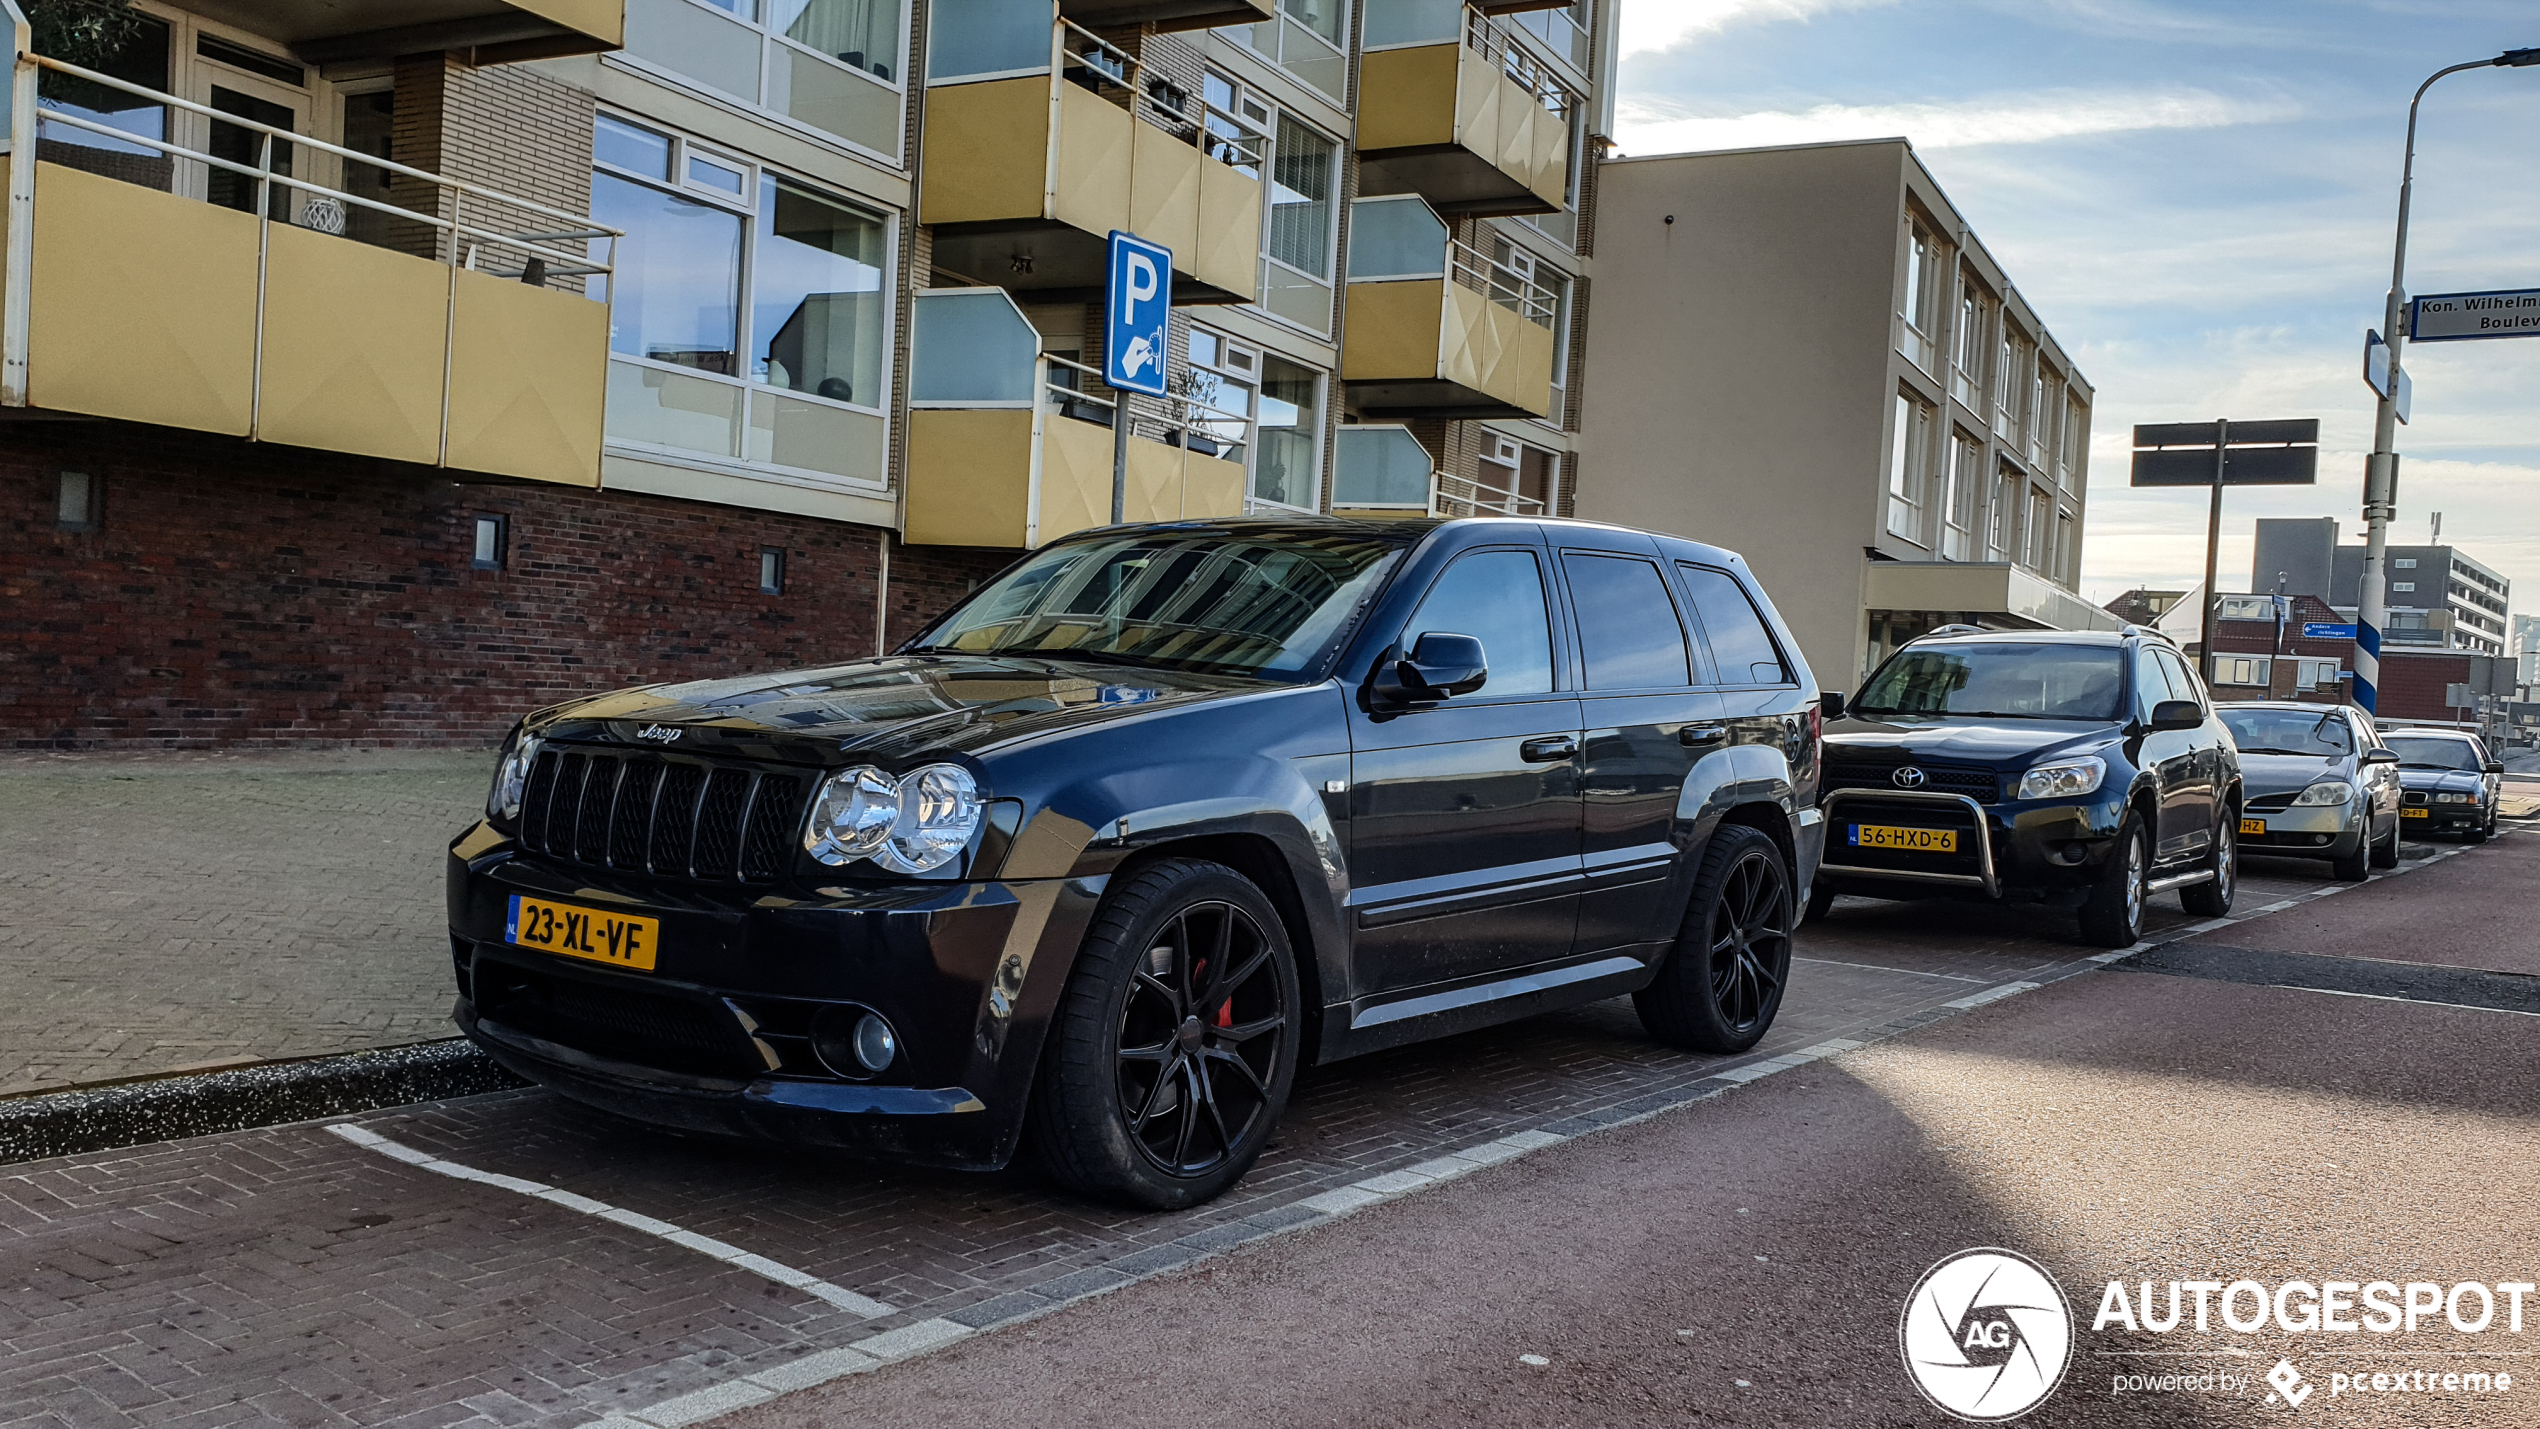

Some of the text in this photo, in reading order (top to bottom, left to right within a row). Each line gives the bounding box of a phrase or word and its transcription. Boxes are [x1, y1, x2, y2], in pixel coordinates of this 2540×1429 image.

[1124, 251, 1158, 326] P
[2421, 300, 2458, 314] Kon.
[2480, 315, 2540, 329] Boulev
[637, 723, 682, 745] Jeep
[1863, 828, 1951, 849] 56-HXD-6
[507, 923, 516, 935] NL
[524, 905, 643, 960] 23-XL-VF
